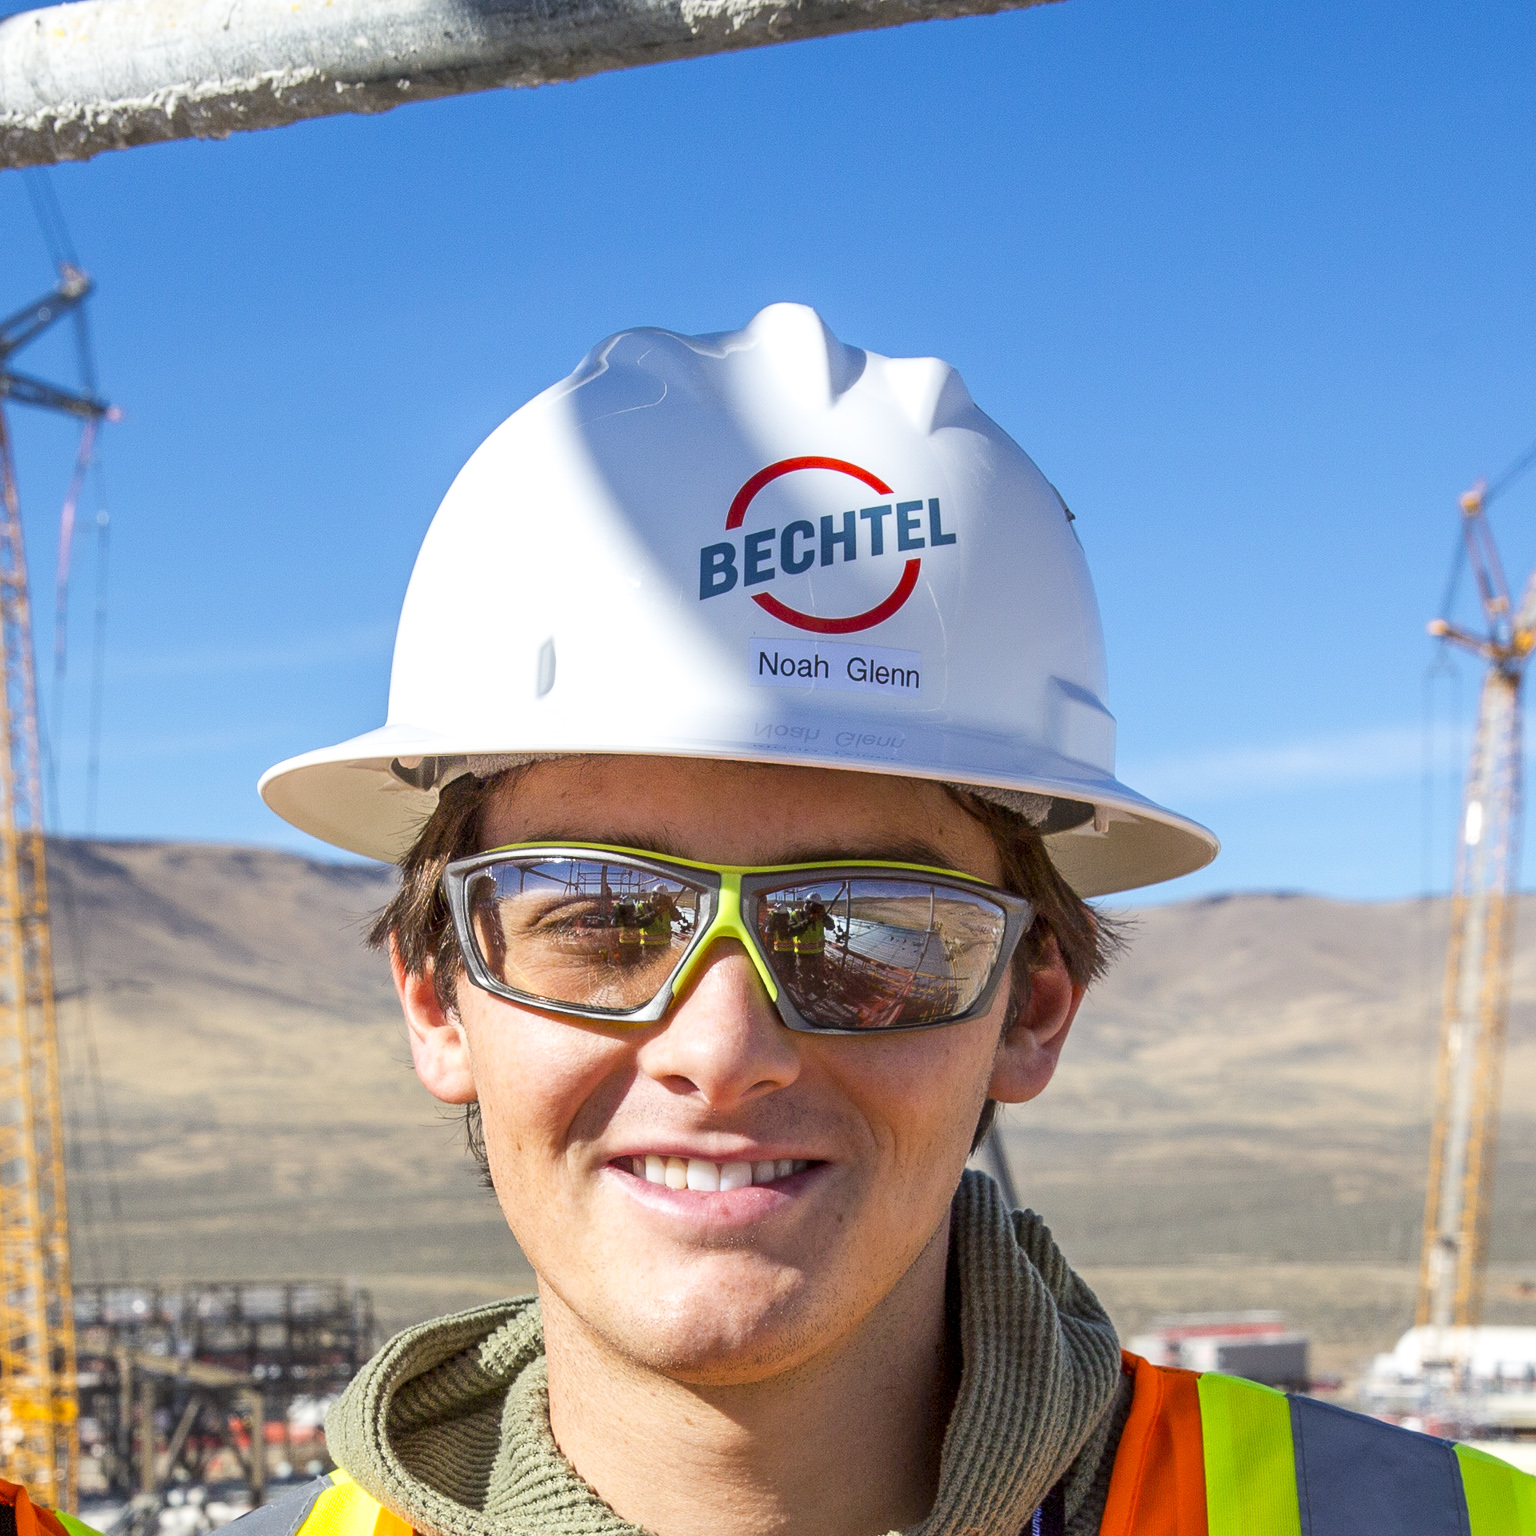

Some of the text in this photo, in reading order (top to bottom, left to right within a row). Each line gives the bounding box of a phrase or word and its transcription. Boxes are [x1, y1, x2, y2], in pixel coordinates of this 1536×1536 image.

[698, 497, 957, 601] BECHTEL
[758, 651, 920, 689] Noah Glenn
